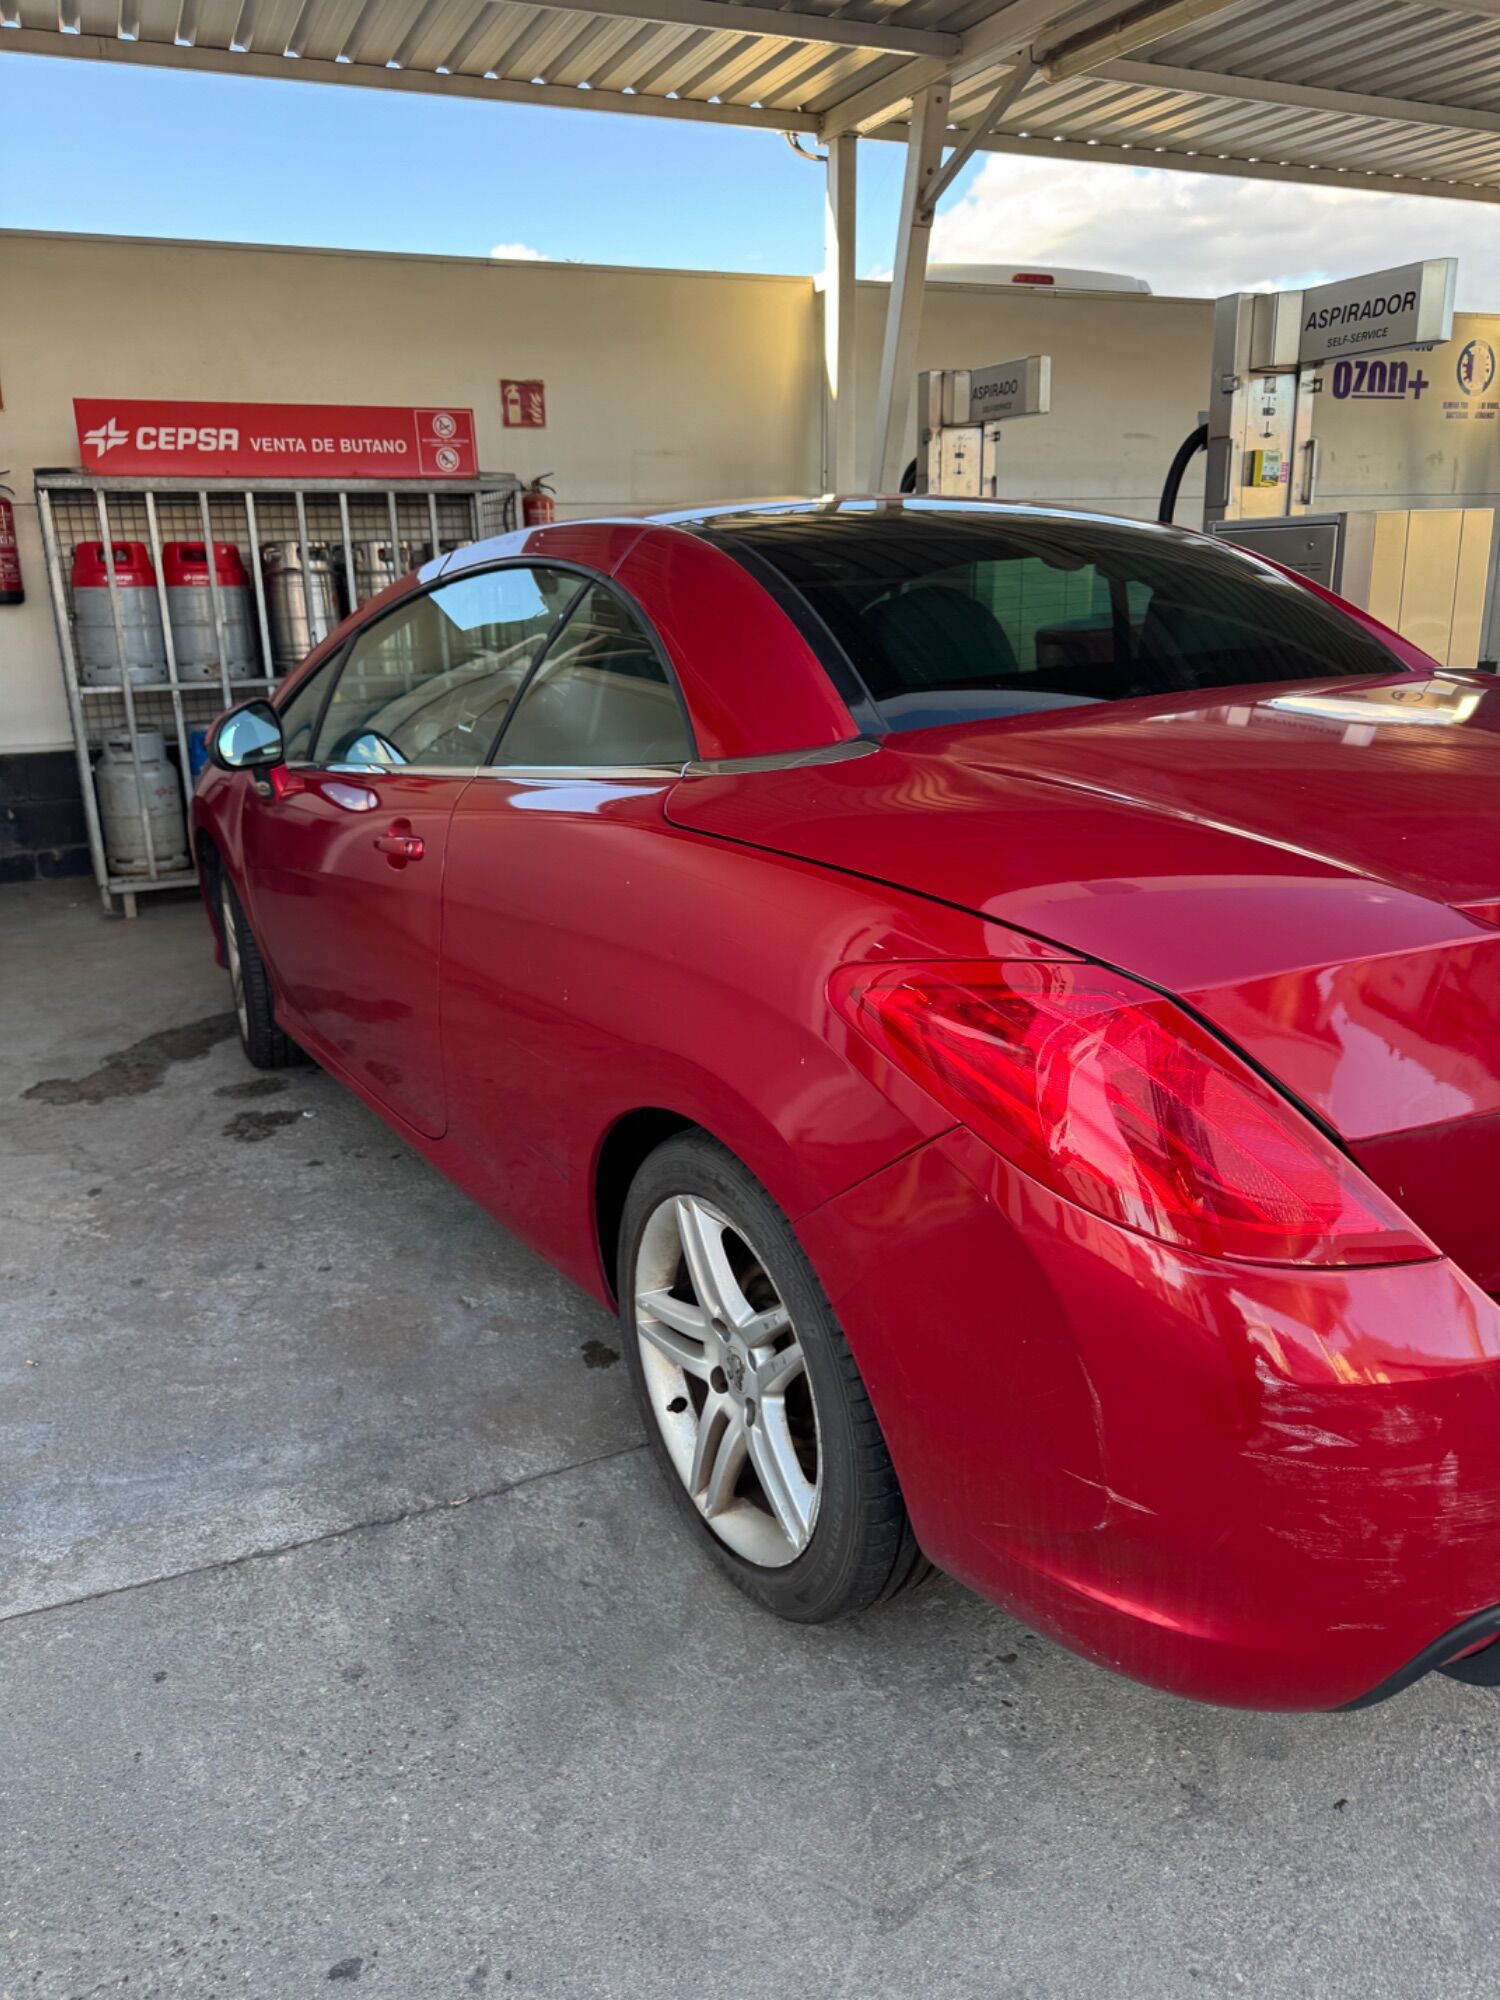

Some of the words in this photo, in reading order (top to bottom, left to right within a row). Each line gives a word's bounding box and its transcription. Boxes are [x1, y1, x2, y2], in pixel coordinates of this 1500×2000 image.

[1304, 291, 1416, 331] ASPIRADOR
[1327, 327, 1389, 348] SELF-SERVICE
[135, 426, 240, 451] CEPSA
[249, 437, 307, 453] VENTA
[311, 437, 335, 453] DE
[340, 438, 407, 454] BUTANO
